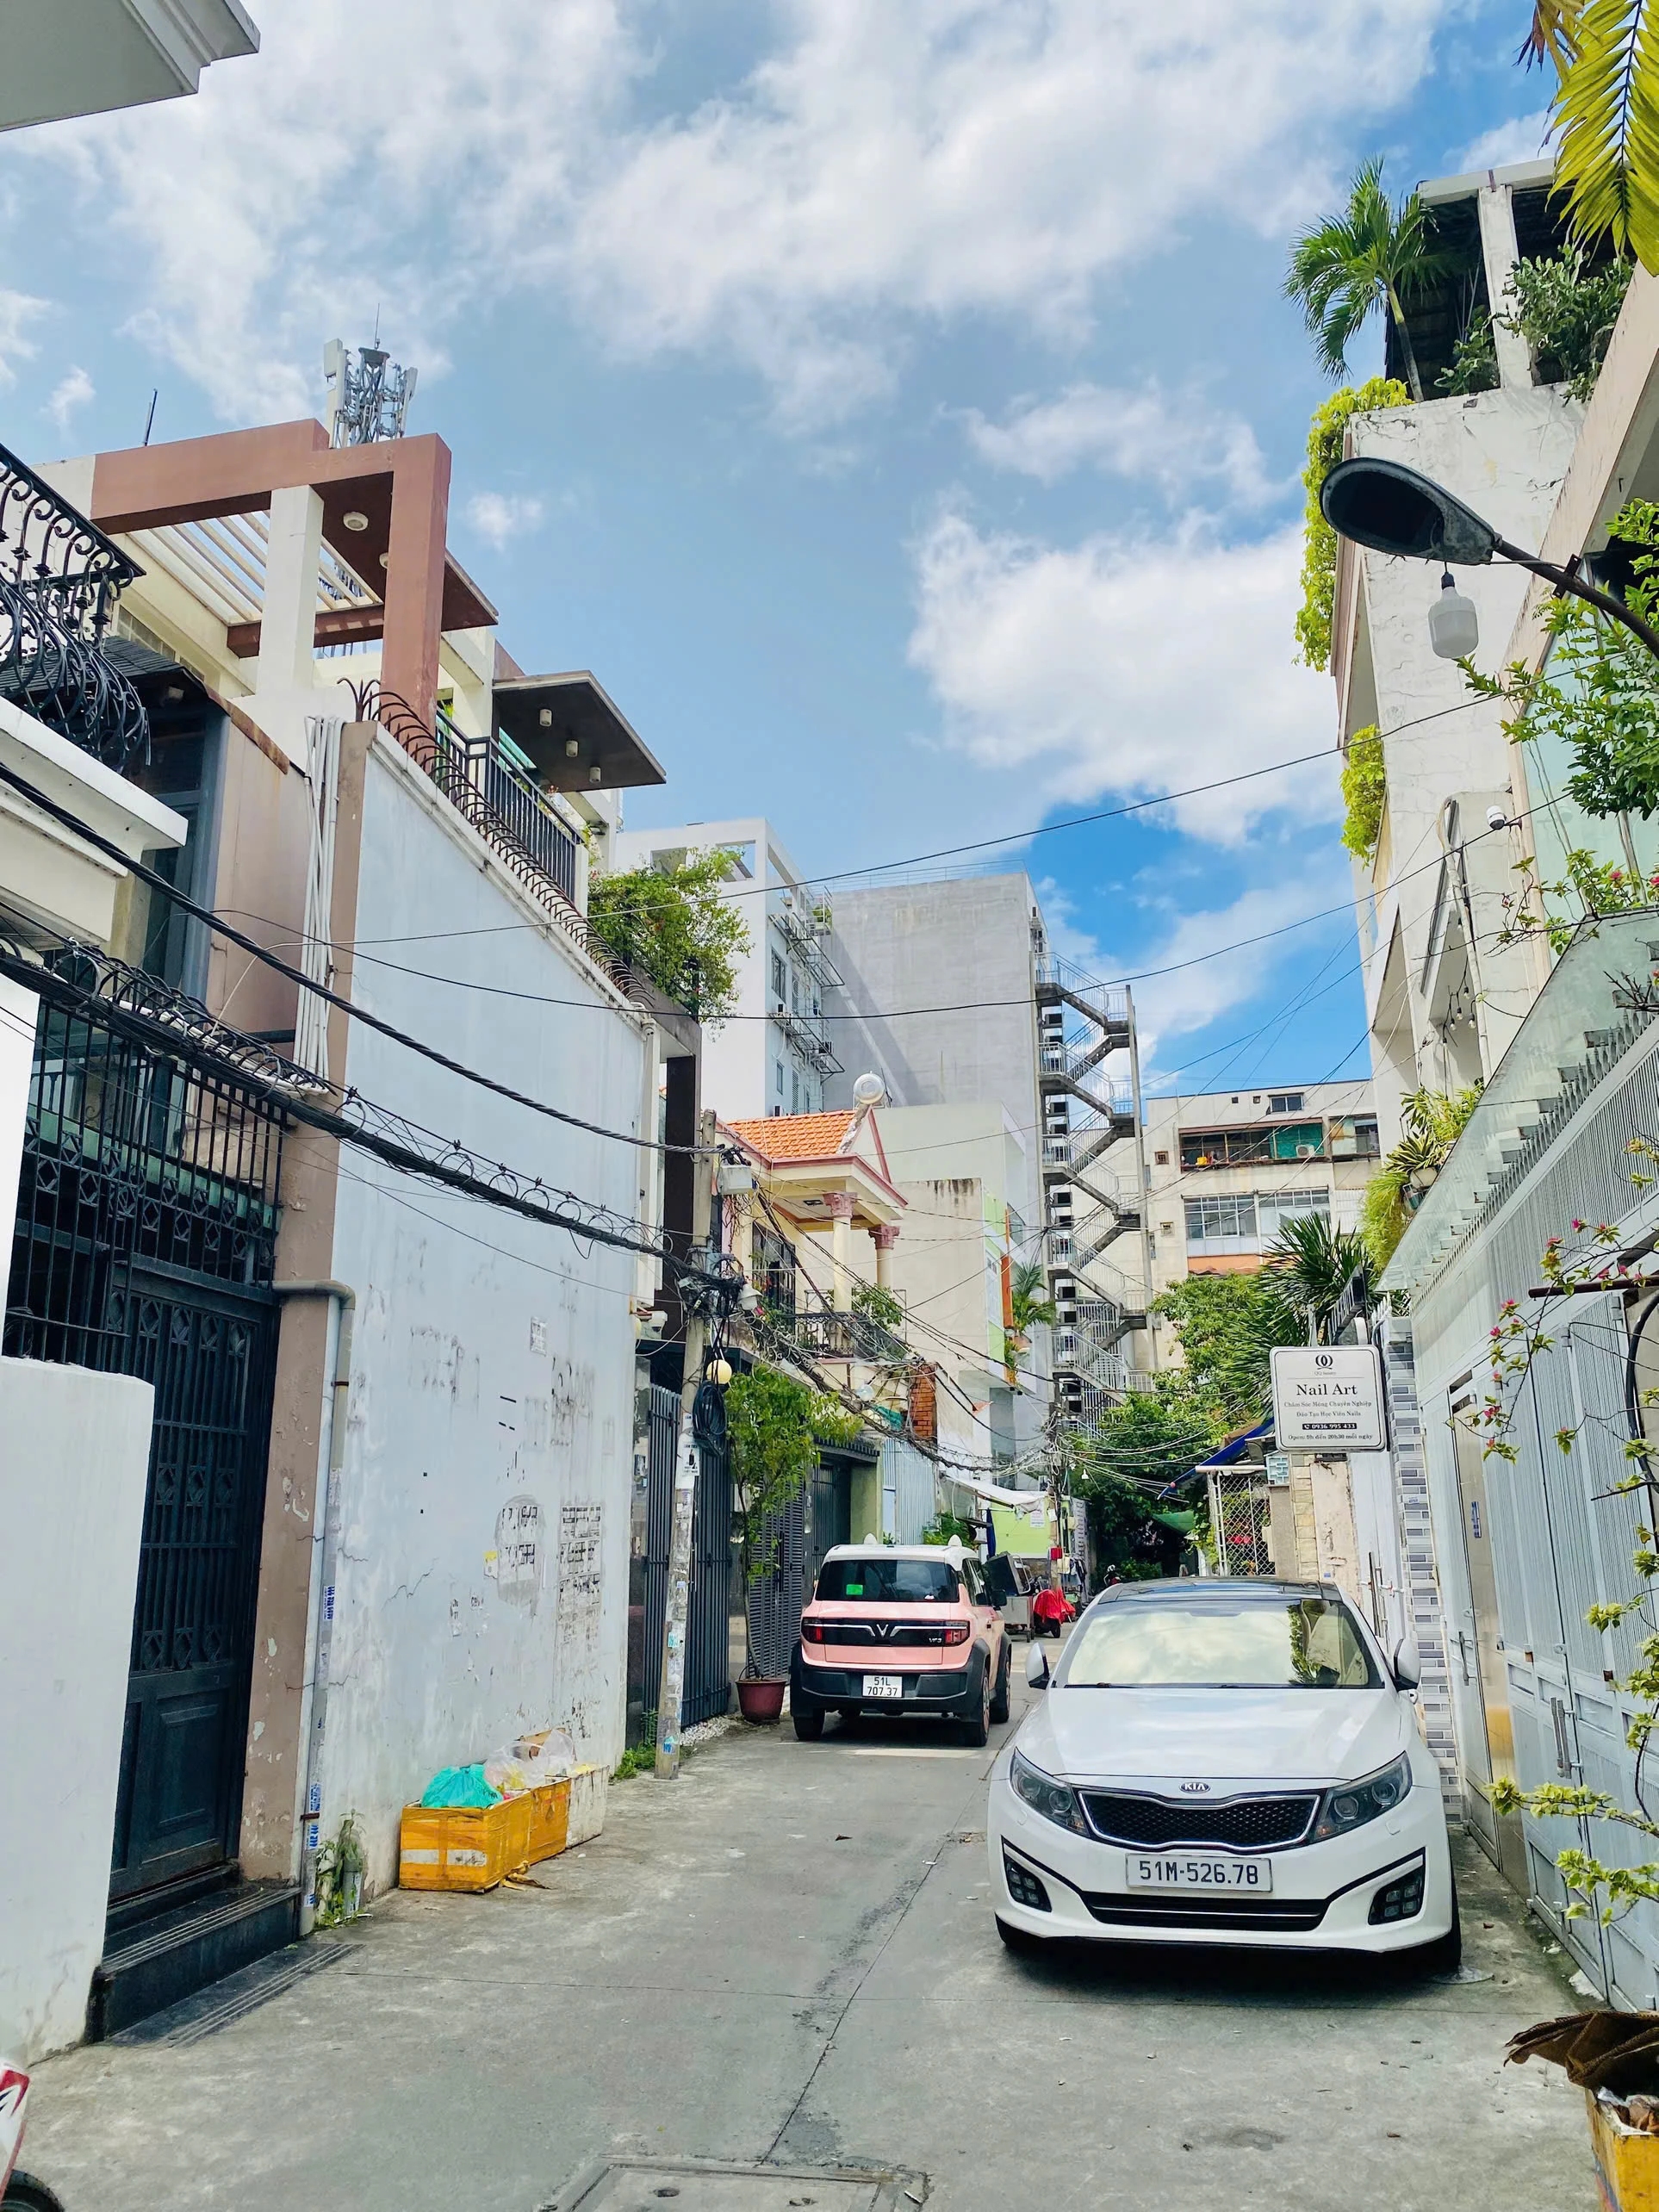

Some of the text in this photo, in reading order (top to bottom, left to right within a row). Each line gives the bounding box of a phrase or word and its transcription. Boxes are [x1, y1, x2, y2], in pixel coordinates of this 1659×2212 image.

[1296, 1383, 1358, 1395] Nail Art
[873, 1676, 891, 1687] 51L
[867, 1687, 898, 1697] 707.37
[1139, 1861, 1258, 1885] 51M-526.78
